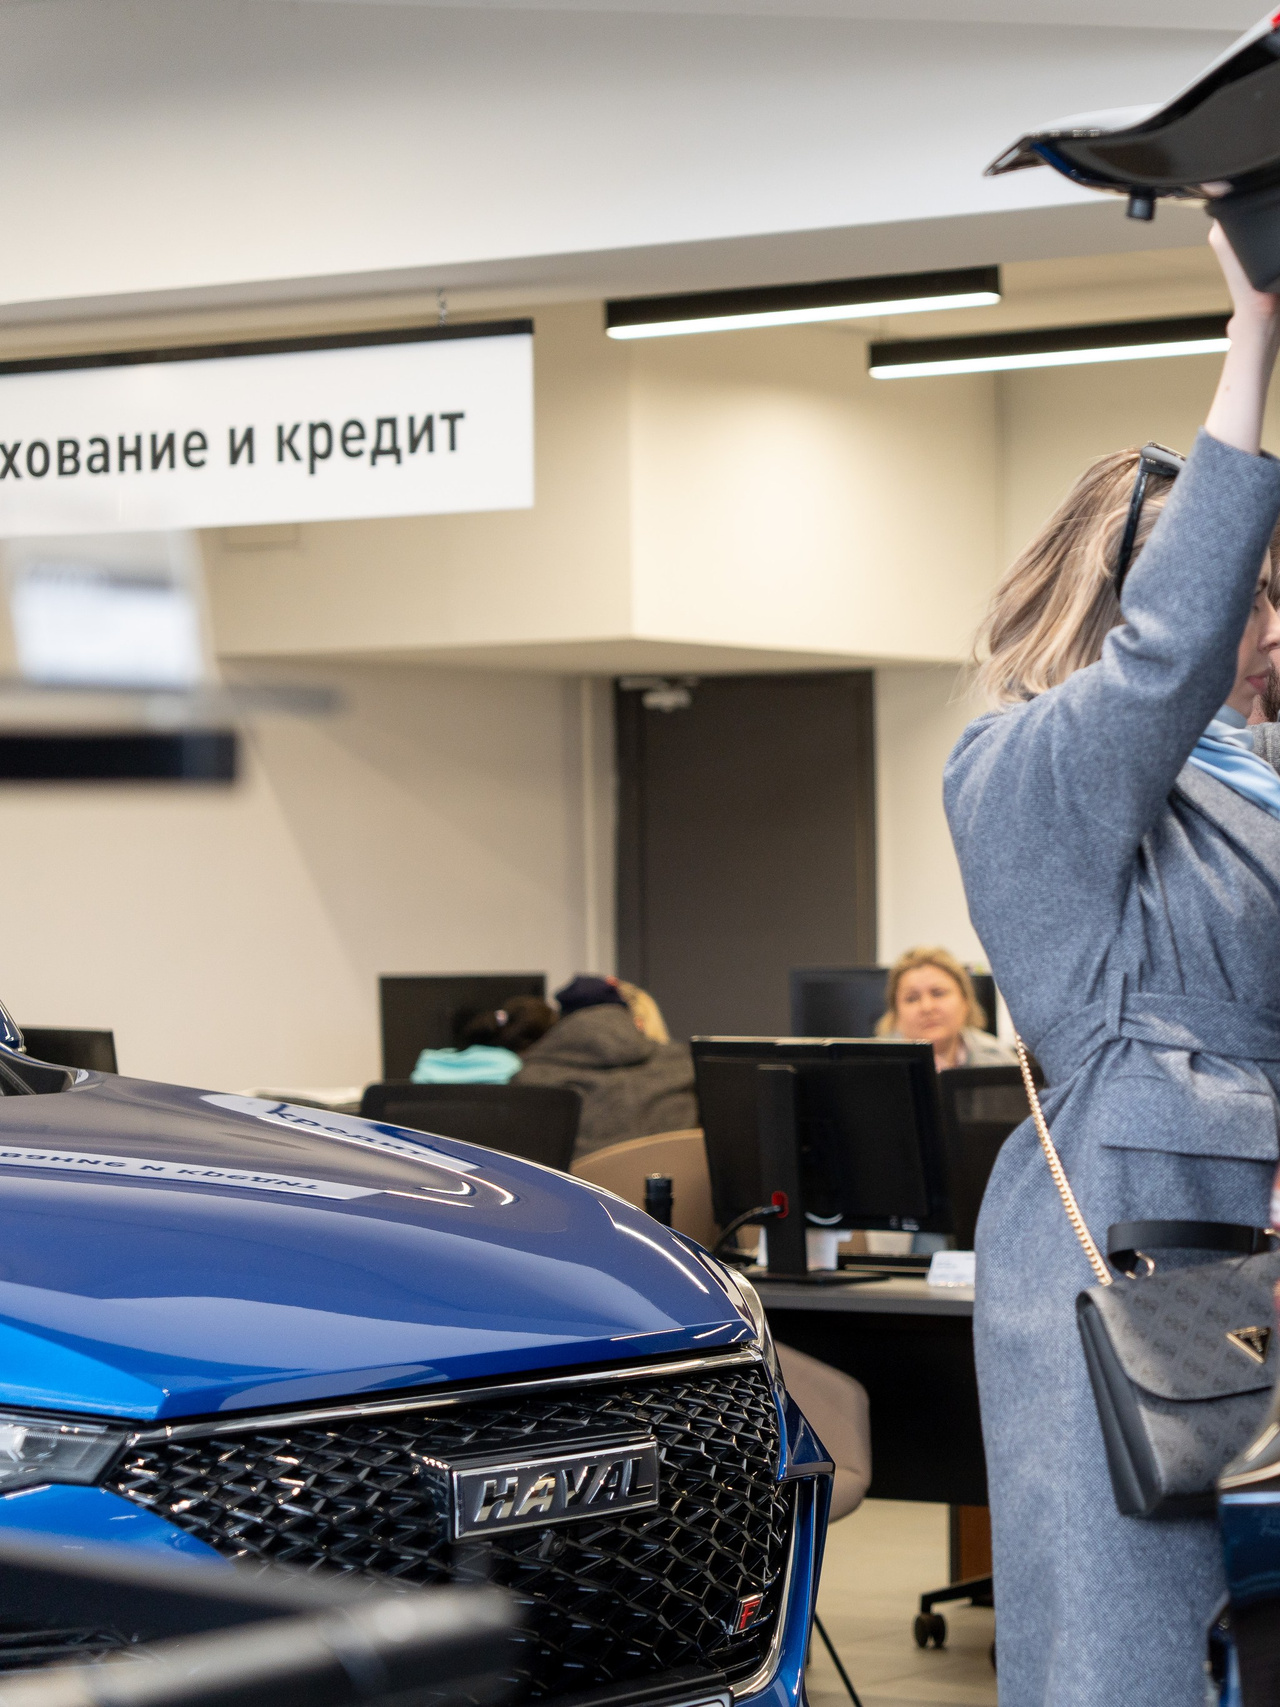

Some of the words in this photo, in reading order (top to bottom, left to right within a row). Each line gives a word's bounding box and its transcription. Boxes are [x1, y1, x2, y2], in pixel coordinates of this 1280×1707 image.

[228, 426, 255, 466] и
[276, 410, 466, 476] кредит
[473, 1456, 654, 1523] HAVAL
[739, 1599, 761, 1630] F
